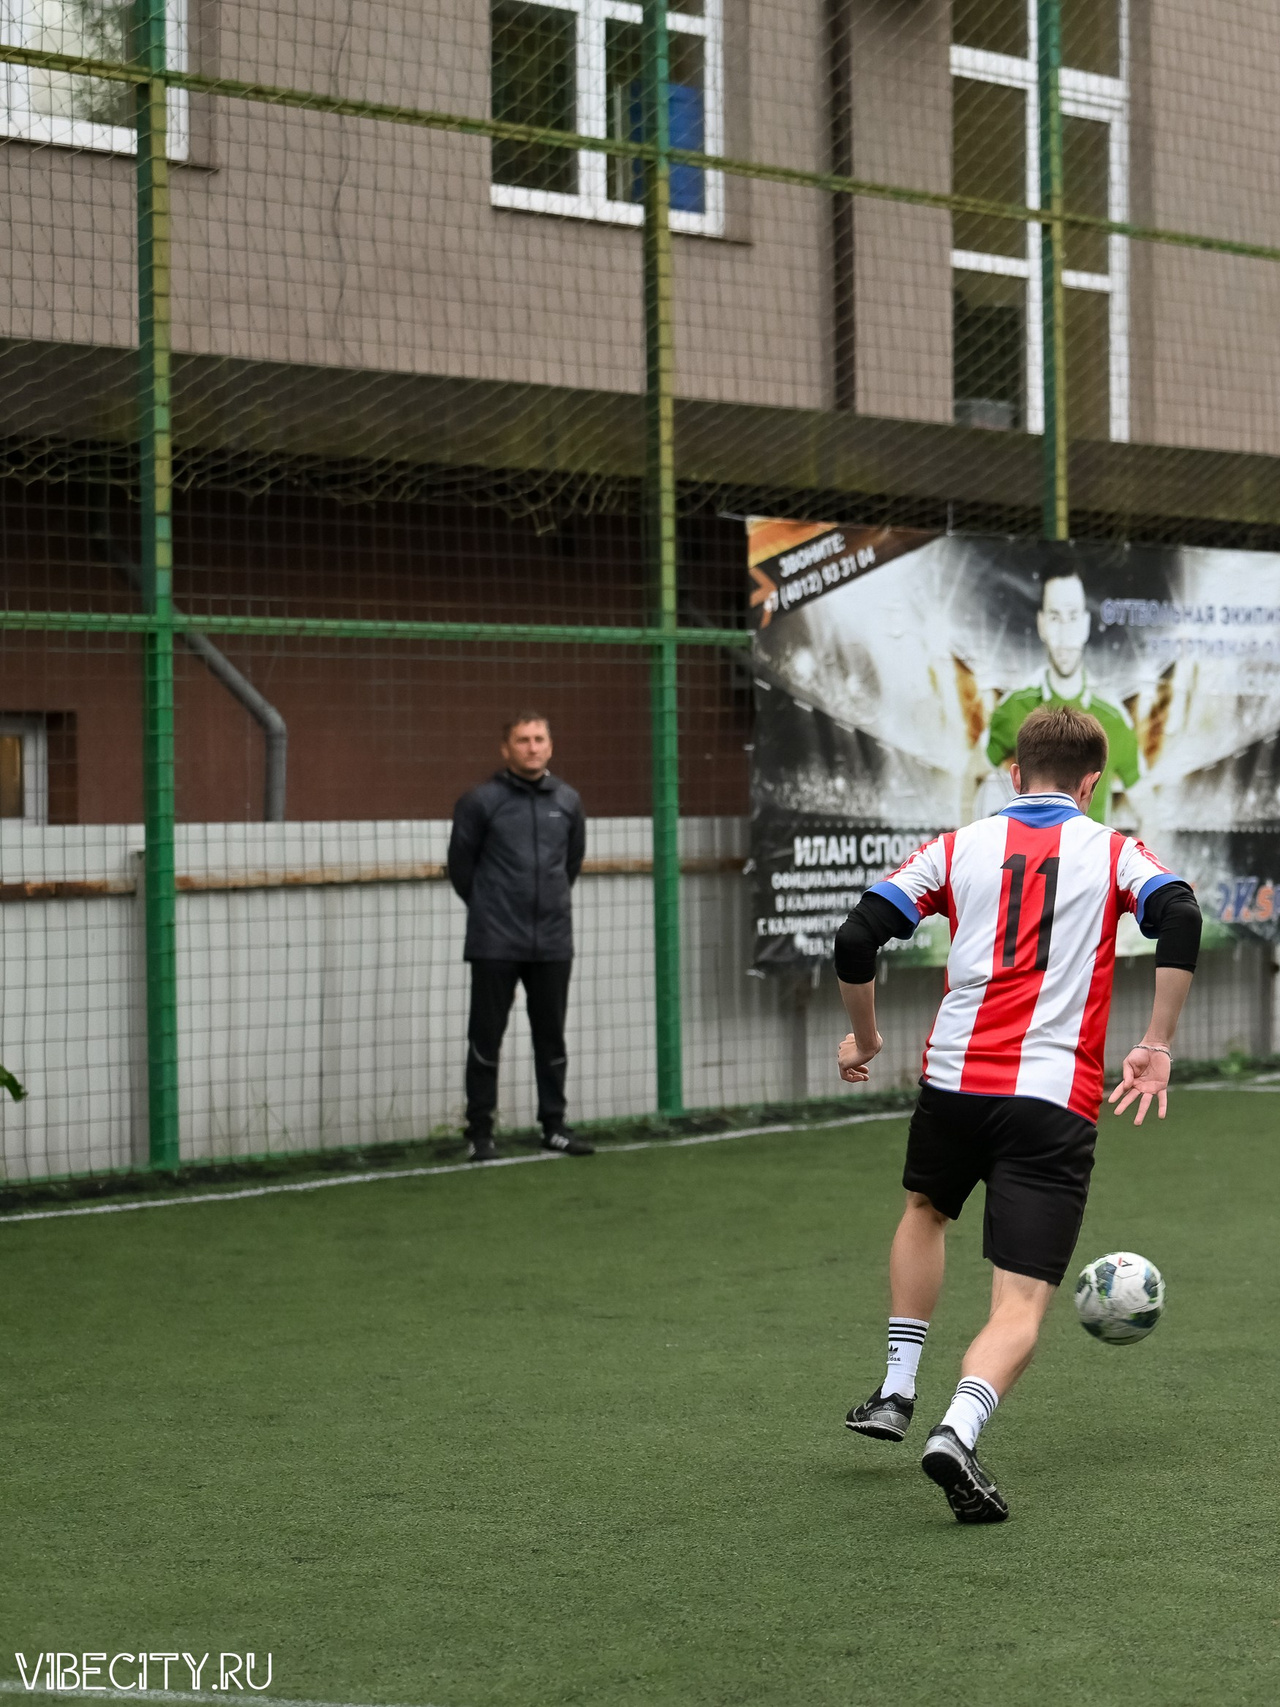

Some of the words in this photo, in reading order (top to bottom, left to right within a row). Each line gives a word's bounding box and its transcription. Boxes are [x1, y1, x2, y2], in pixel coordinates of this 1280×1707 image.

[839, 554, 858, 577] 31
[856, 545, 876, 568] 04
[794, 835, 858, 867] ИЛАН
[1000, 853, 1060, 972] 11
